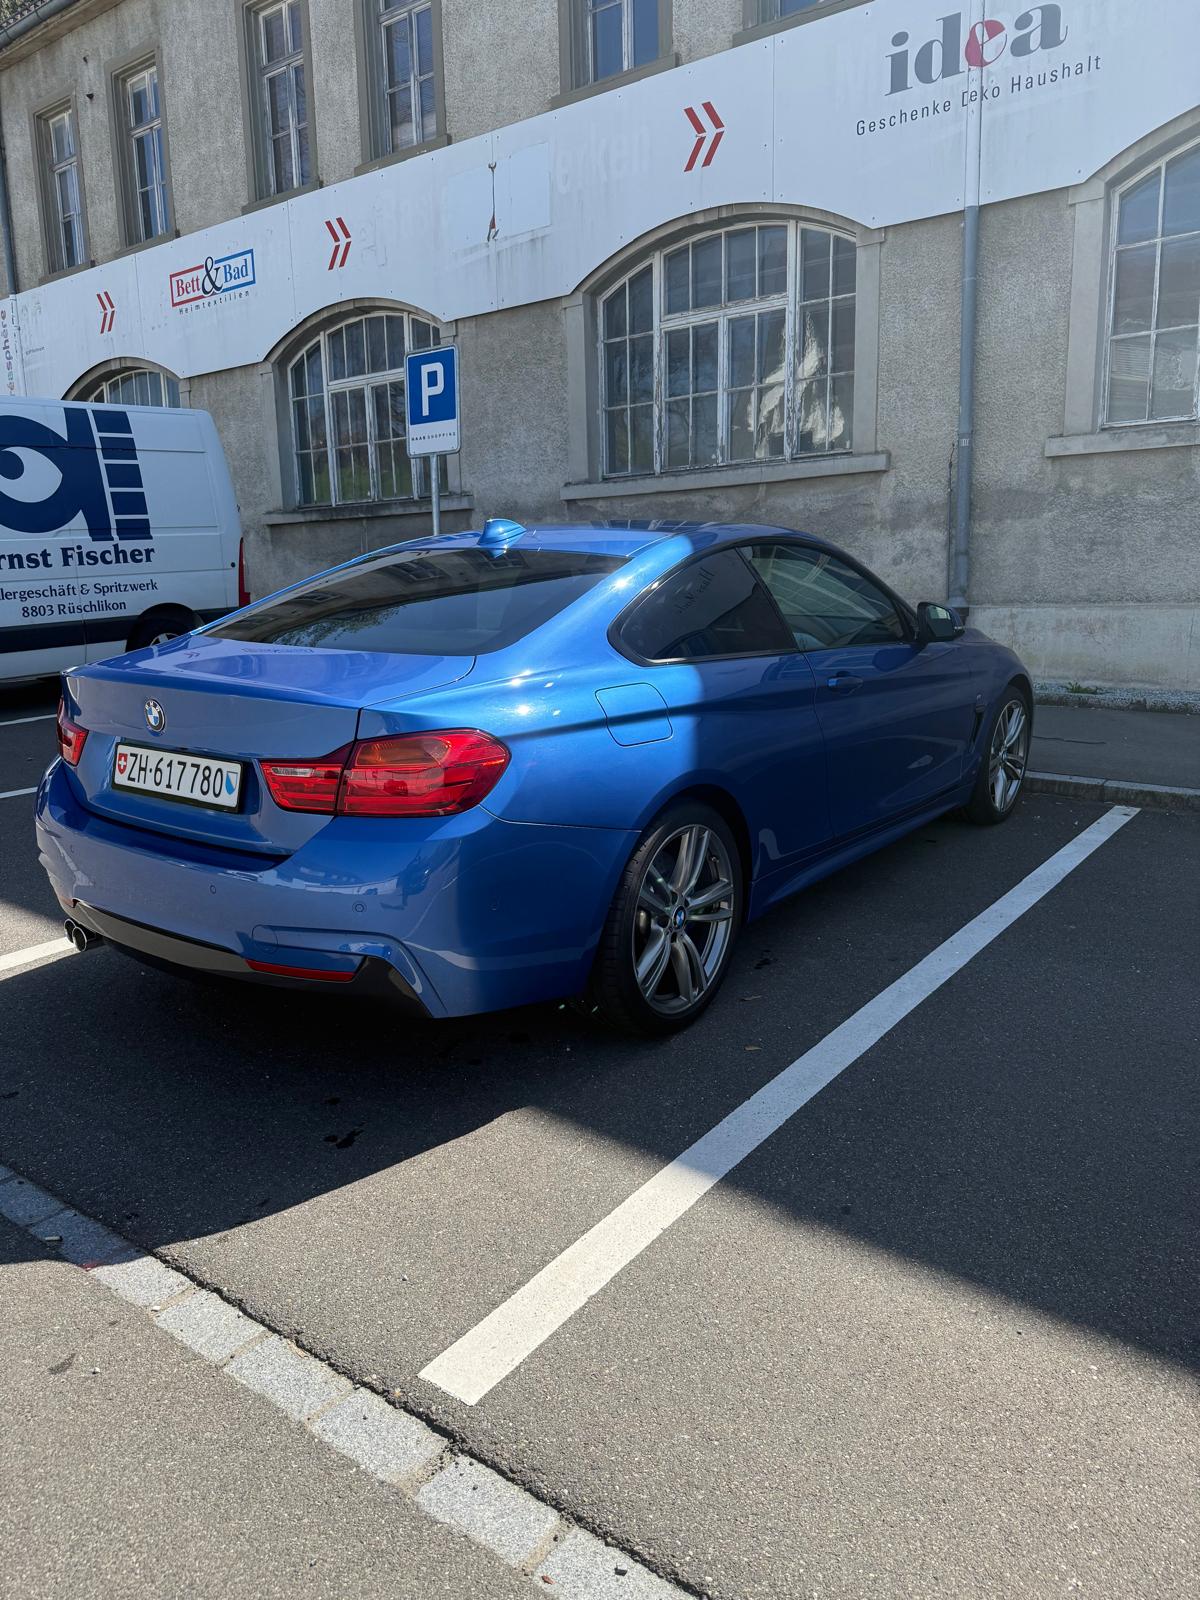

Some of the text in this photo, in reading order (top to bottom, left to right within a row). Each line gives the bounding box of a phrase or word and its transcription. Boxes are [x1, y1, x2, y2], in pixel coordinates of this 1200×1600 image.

[884, 3, 1068, 96] idea
[857, 99, 951, 136] Geschenke
[1010, 55, 1102, 93] Haushalt
[175, 256, 249, 297] Bett & Bad
[179, 290, 249, 315] Heimtextilien
[421, 362, 445, 417] P
[60, 543, 156, 567] Fischer
[80, 583, 91, 595] &
[94, 578, 159, 598] Spritzwerk
[22, 599, 127, 618] 8803 Rüschlikon
